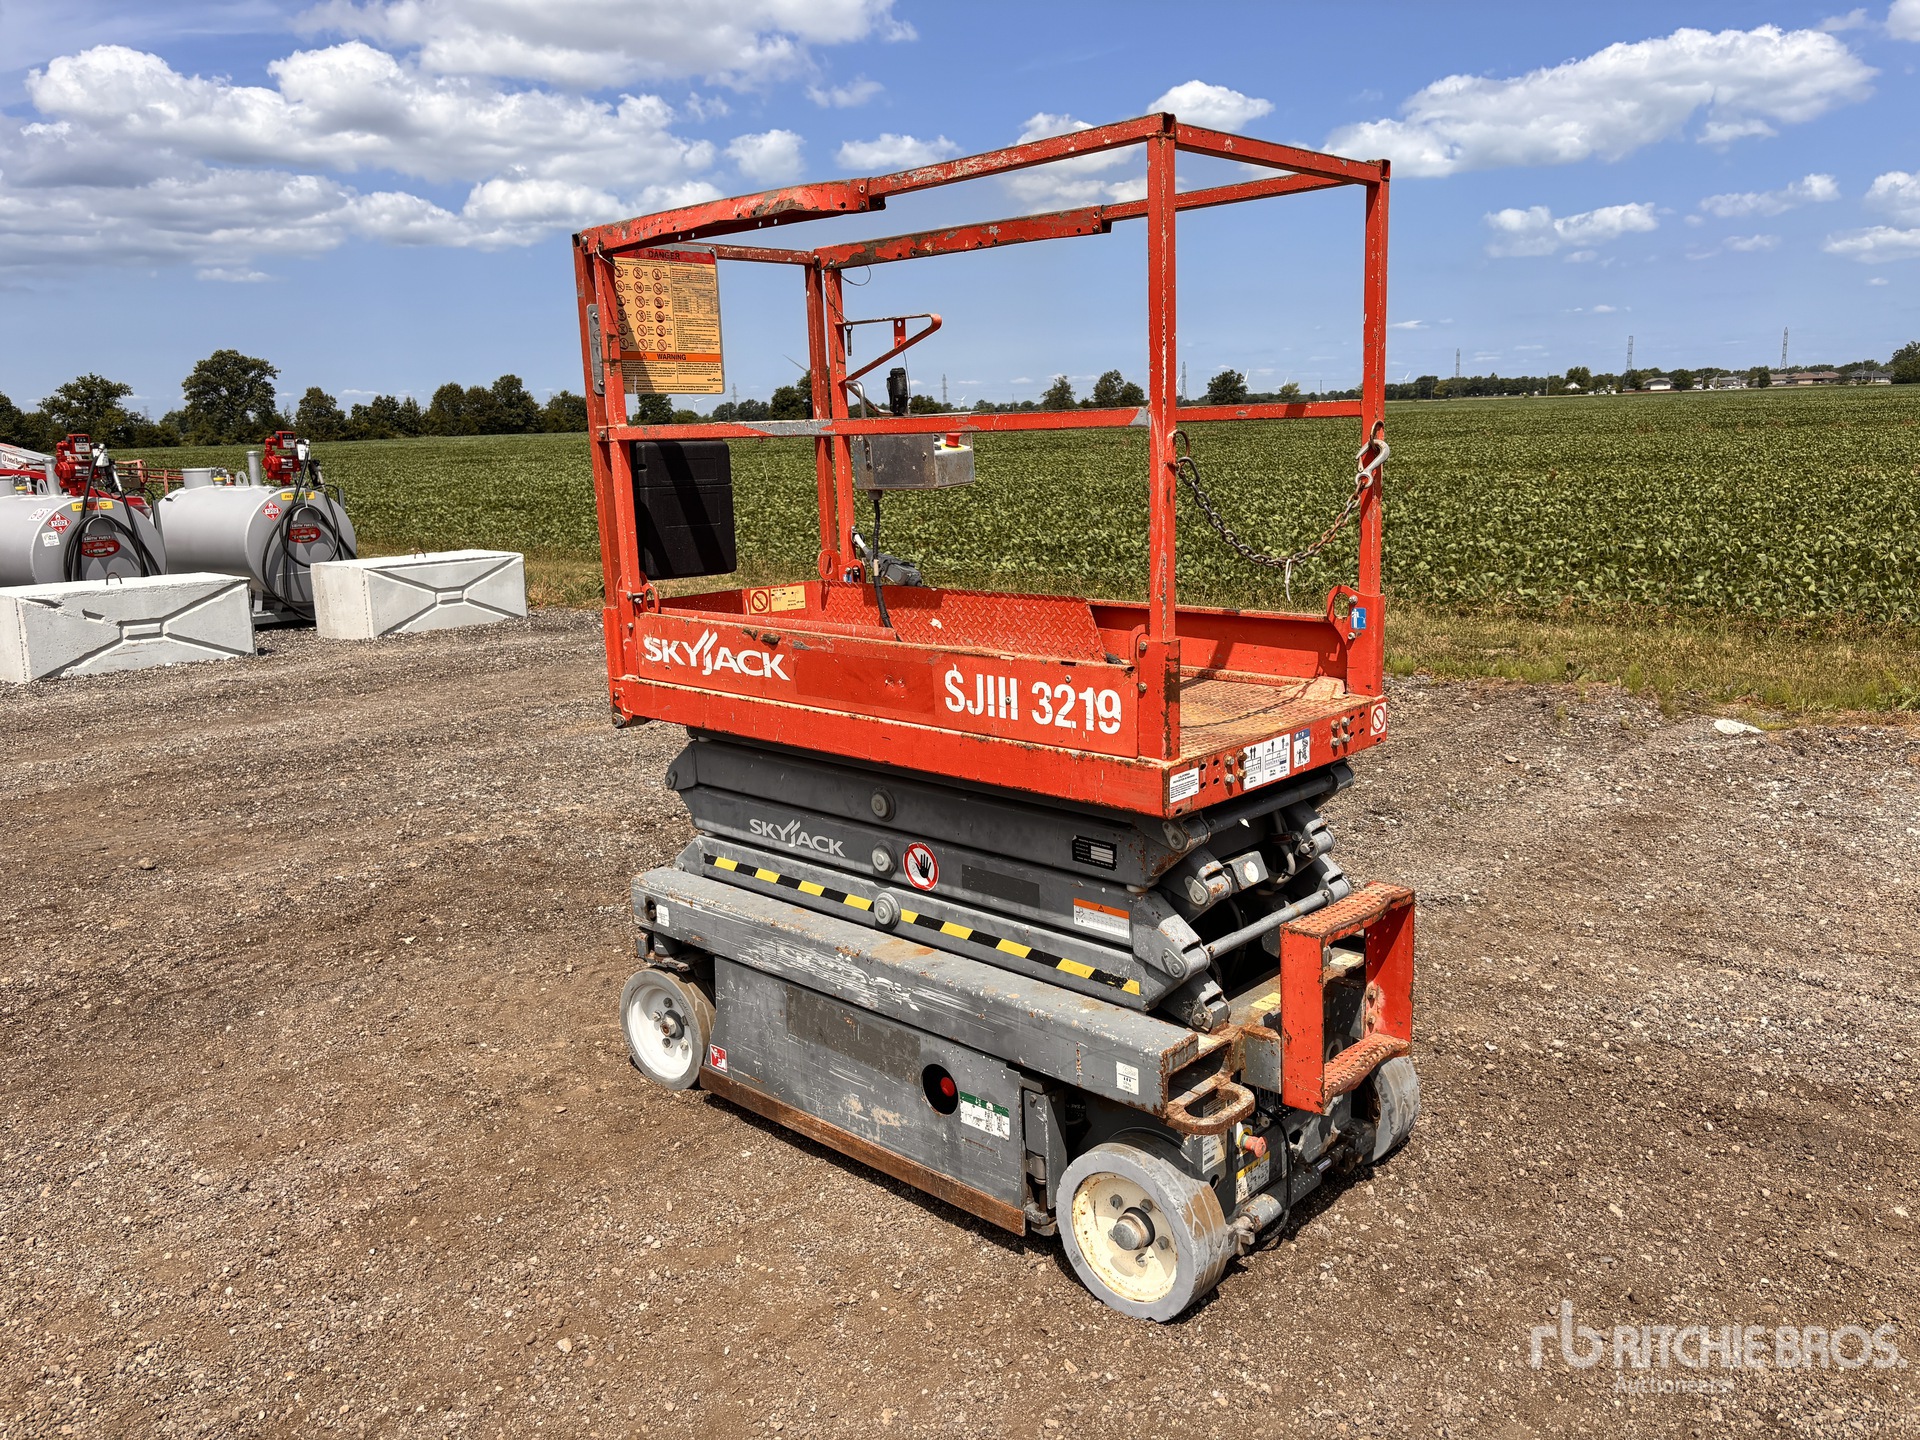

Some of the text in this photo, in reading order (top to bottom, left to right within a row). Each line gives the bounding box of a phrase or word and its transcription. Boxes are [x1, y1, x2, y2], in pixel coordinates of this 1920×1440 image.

[648, 250, 681, 260] DANGER
[657, 353, 687, 361] WARNING
[643, 628, 791, 681] SKYJACK
[1031, 681, 1122, 735] 3219
[749, 819, 846, 858] SKYJACK
